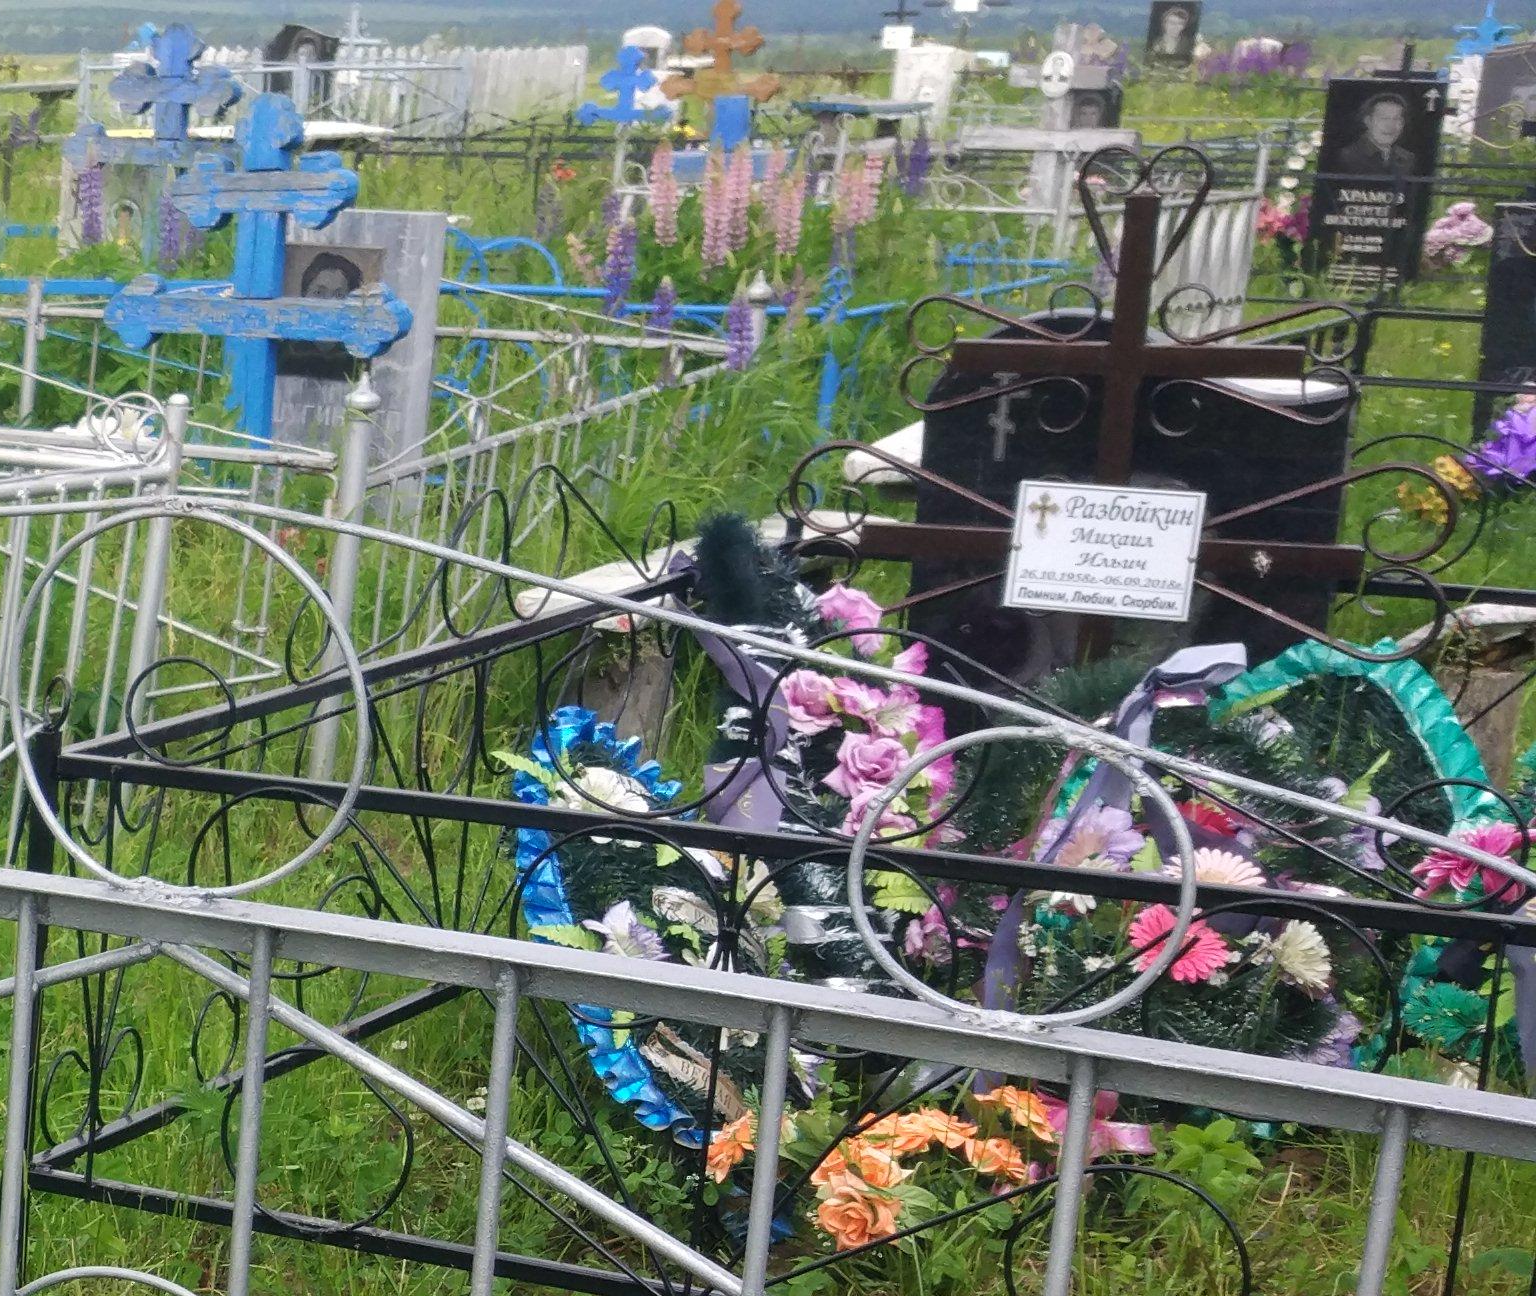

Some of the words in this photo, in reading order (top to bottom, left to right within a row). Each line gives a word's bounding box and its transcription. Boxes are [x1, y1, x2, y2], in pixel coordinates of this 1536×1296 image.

[1066, 495, 1195, 531] Разбойкин
[1070, 527, 1154, 549] Михаил
[1075, 552, 1147, 571] Ильич
[1018, 586, 1069, 603] Помним,
[1072, 590, 1118, 606] Любим,
[1122, 594, 1179, 611] Скорбим.
